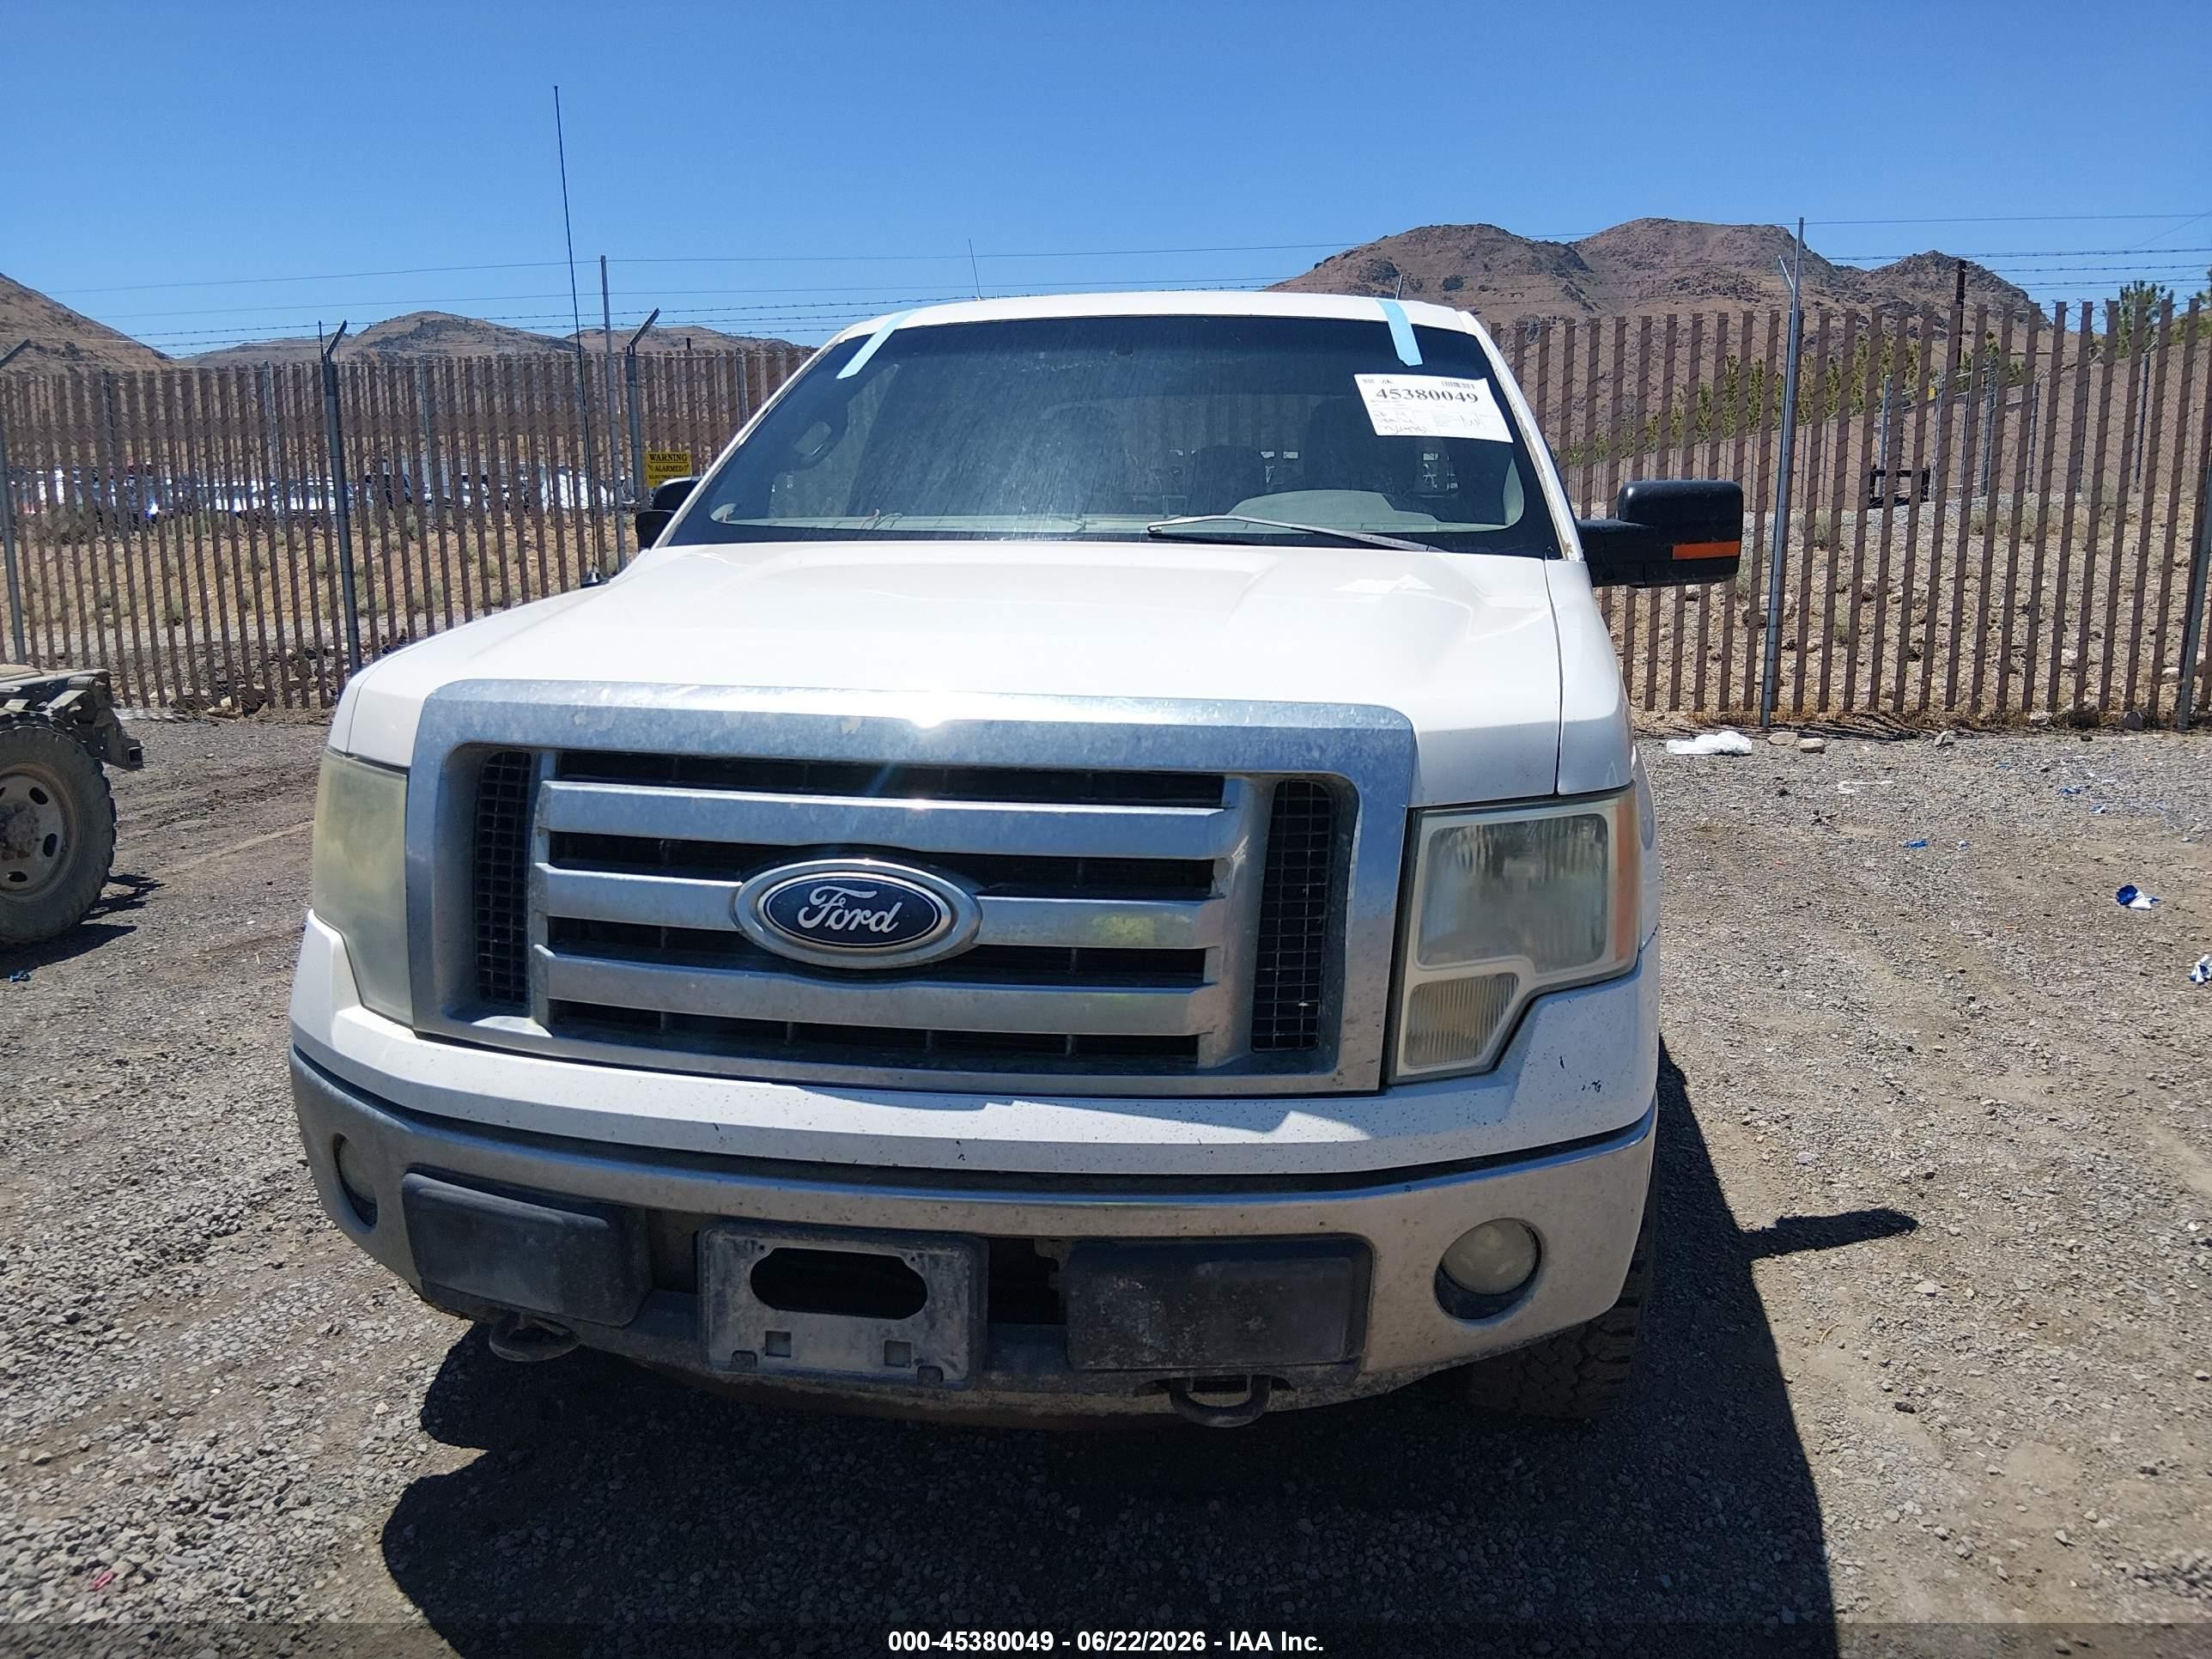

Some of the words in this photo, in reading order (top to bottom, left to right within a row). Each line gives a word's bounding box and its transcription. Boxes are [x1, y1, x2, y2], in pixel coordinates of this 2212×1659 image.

[1376, 388, 1479, 404] 45380049
[649, 453, 687, 462] WARNING
[798, 885, 902, 933] Ford
